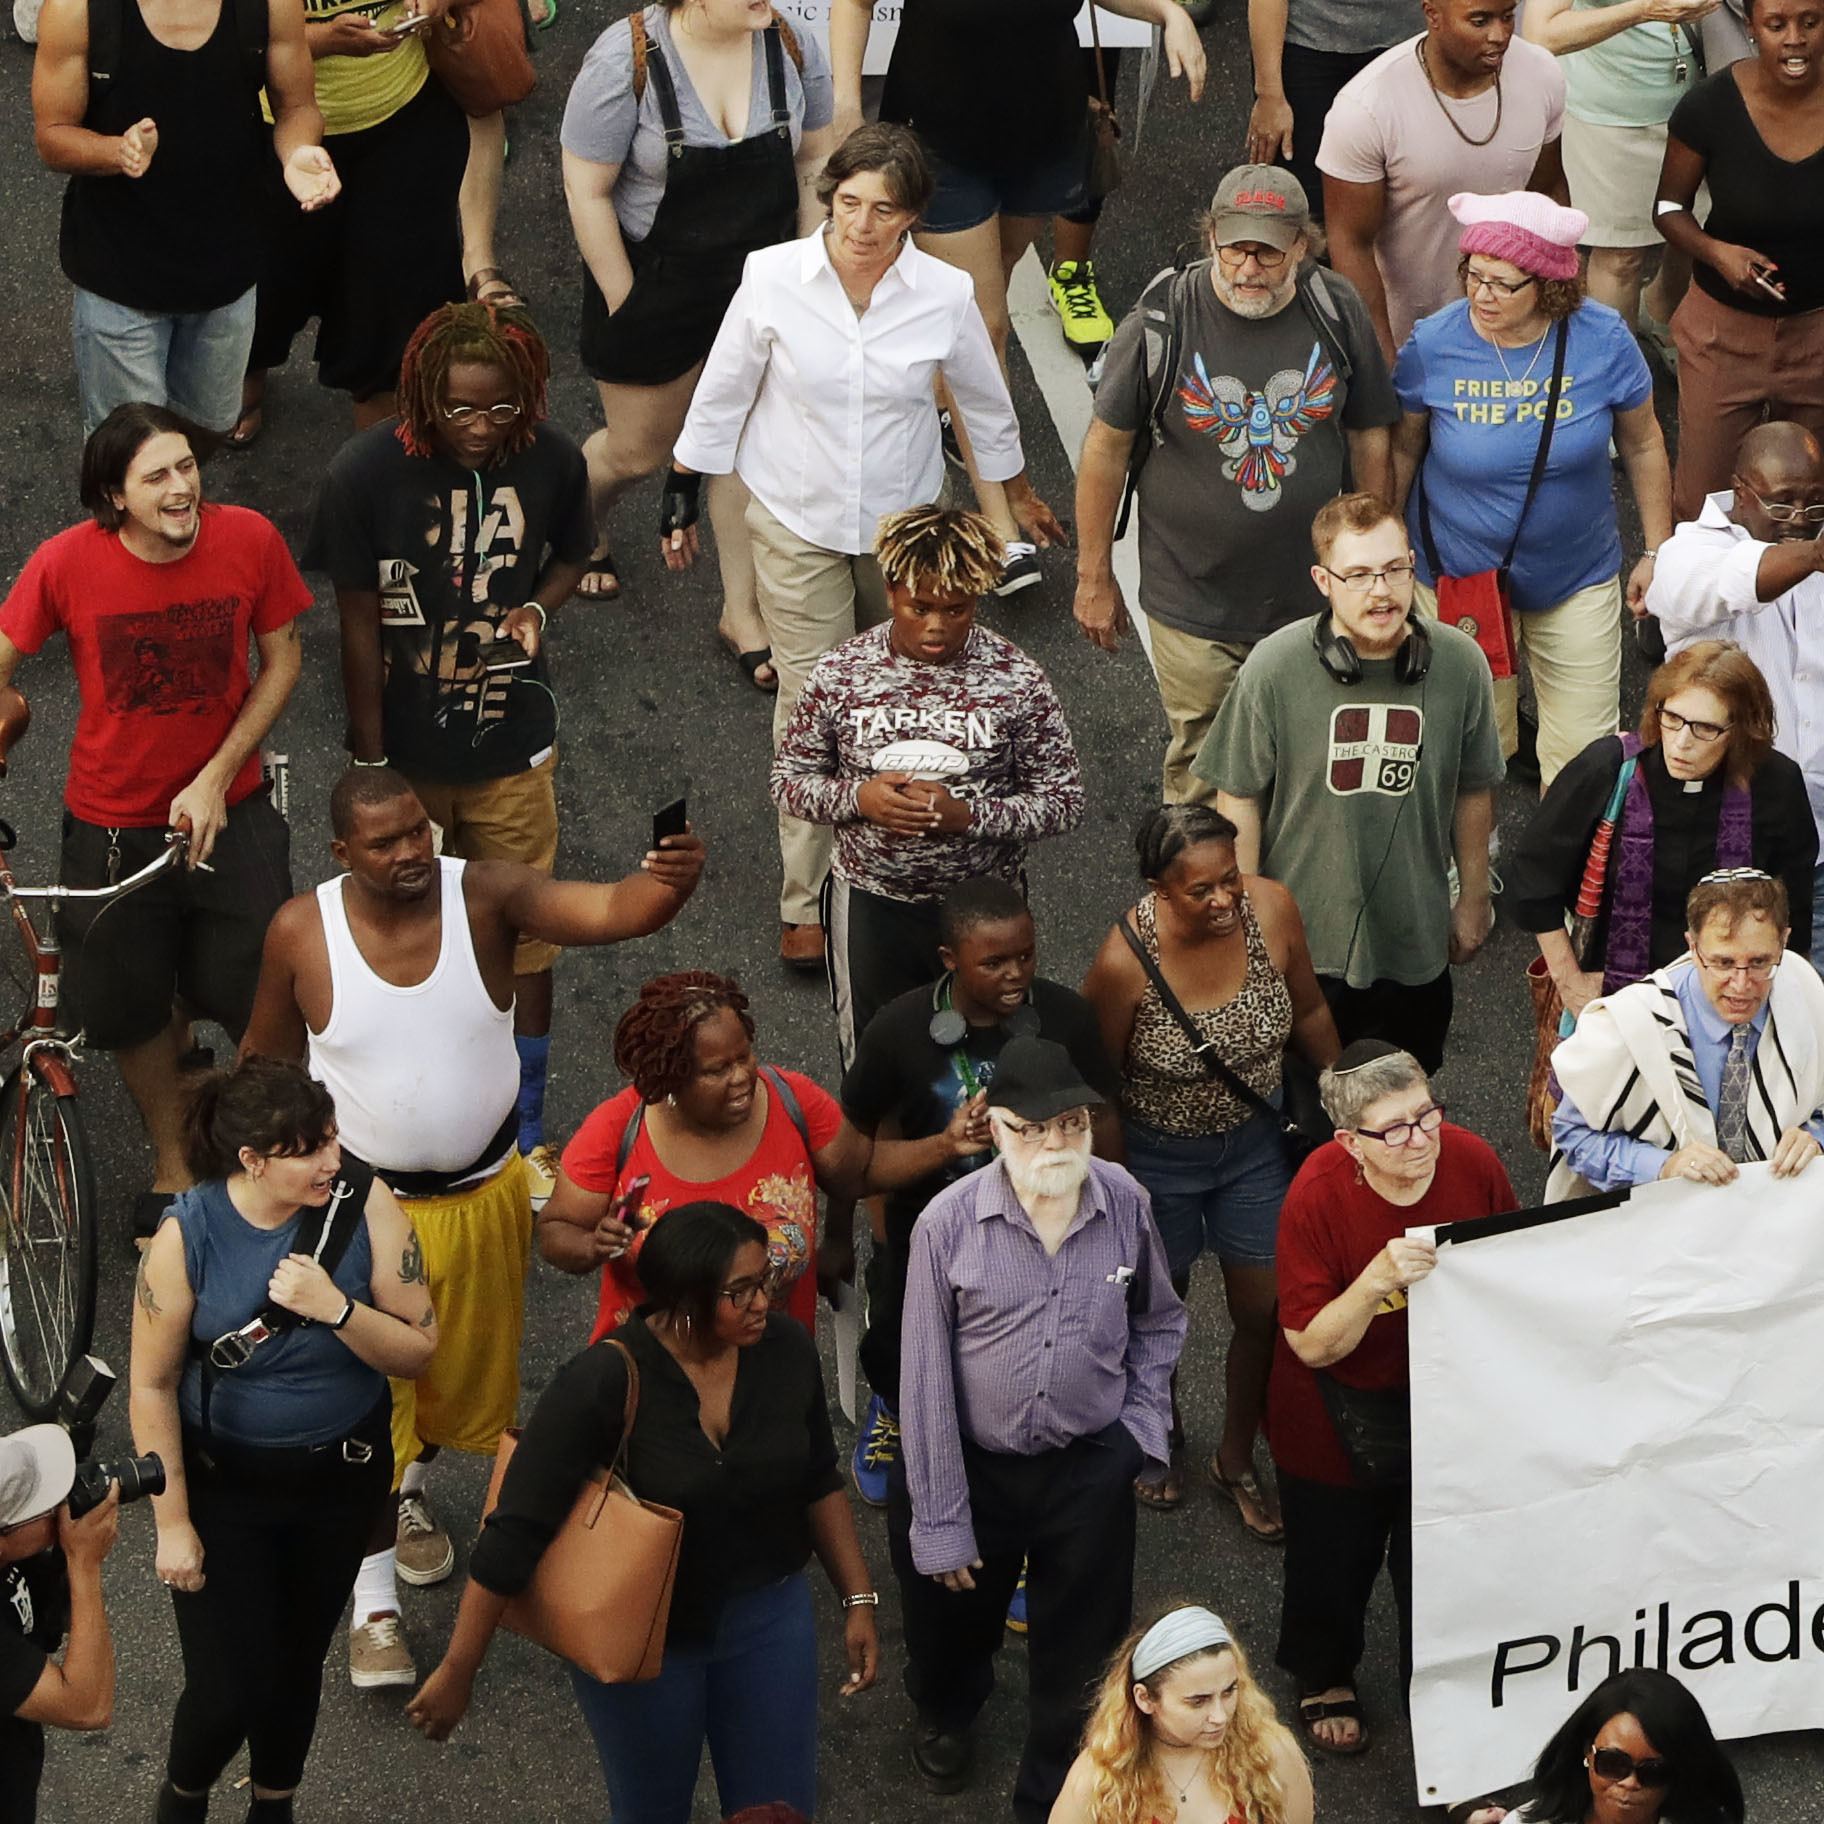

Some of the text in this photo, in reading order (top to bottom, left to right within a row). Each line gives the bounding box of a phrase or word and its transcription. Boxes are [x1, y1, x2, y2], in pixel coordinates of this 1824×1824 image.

[1452, 403, 1506, 425] THE
[849, 706, 994, 751] TARKEN
[1333, 742, 1418, 759] THE CASTRO
[1381, 763, 1413, 788] 69
